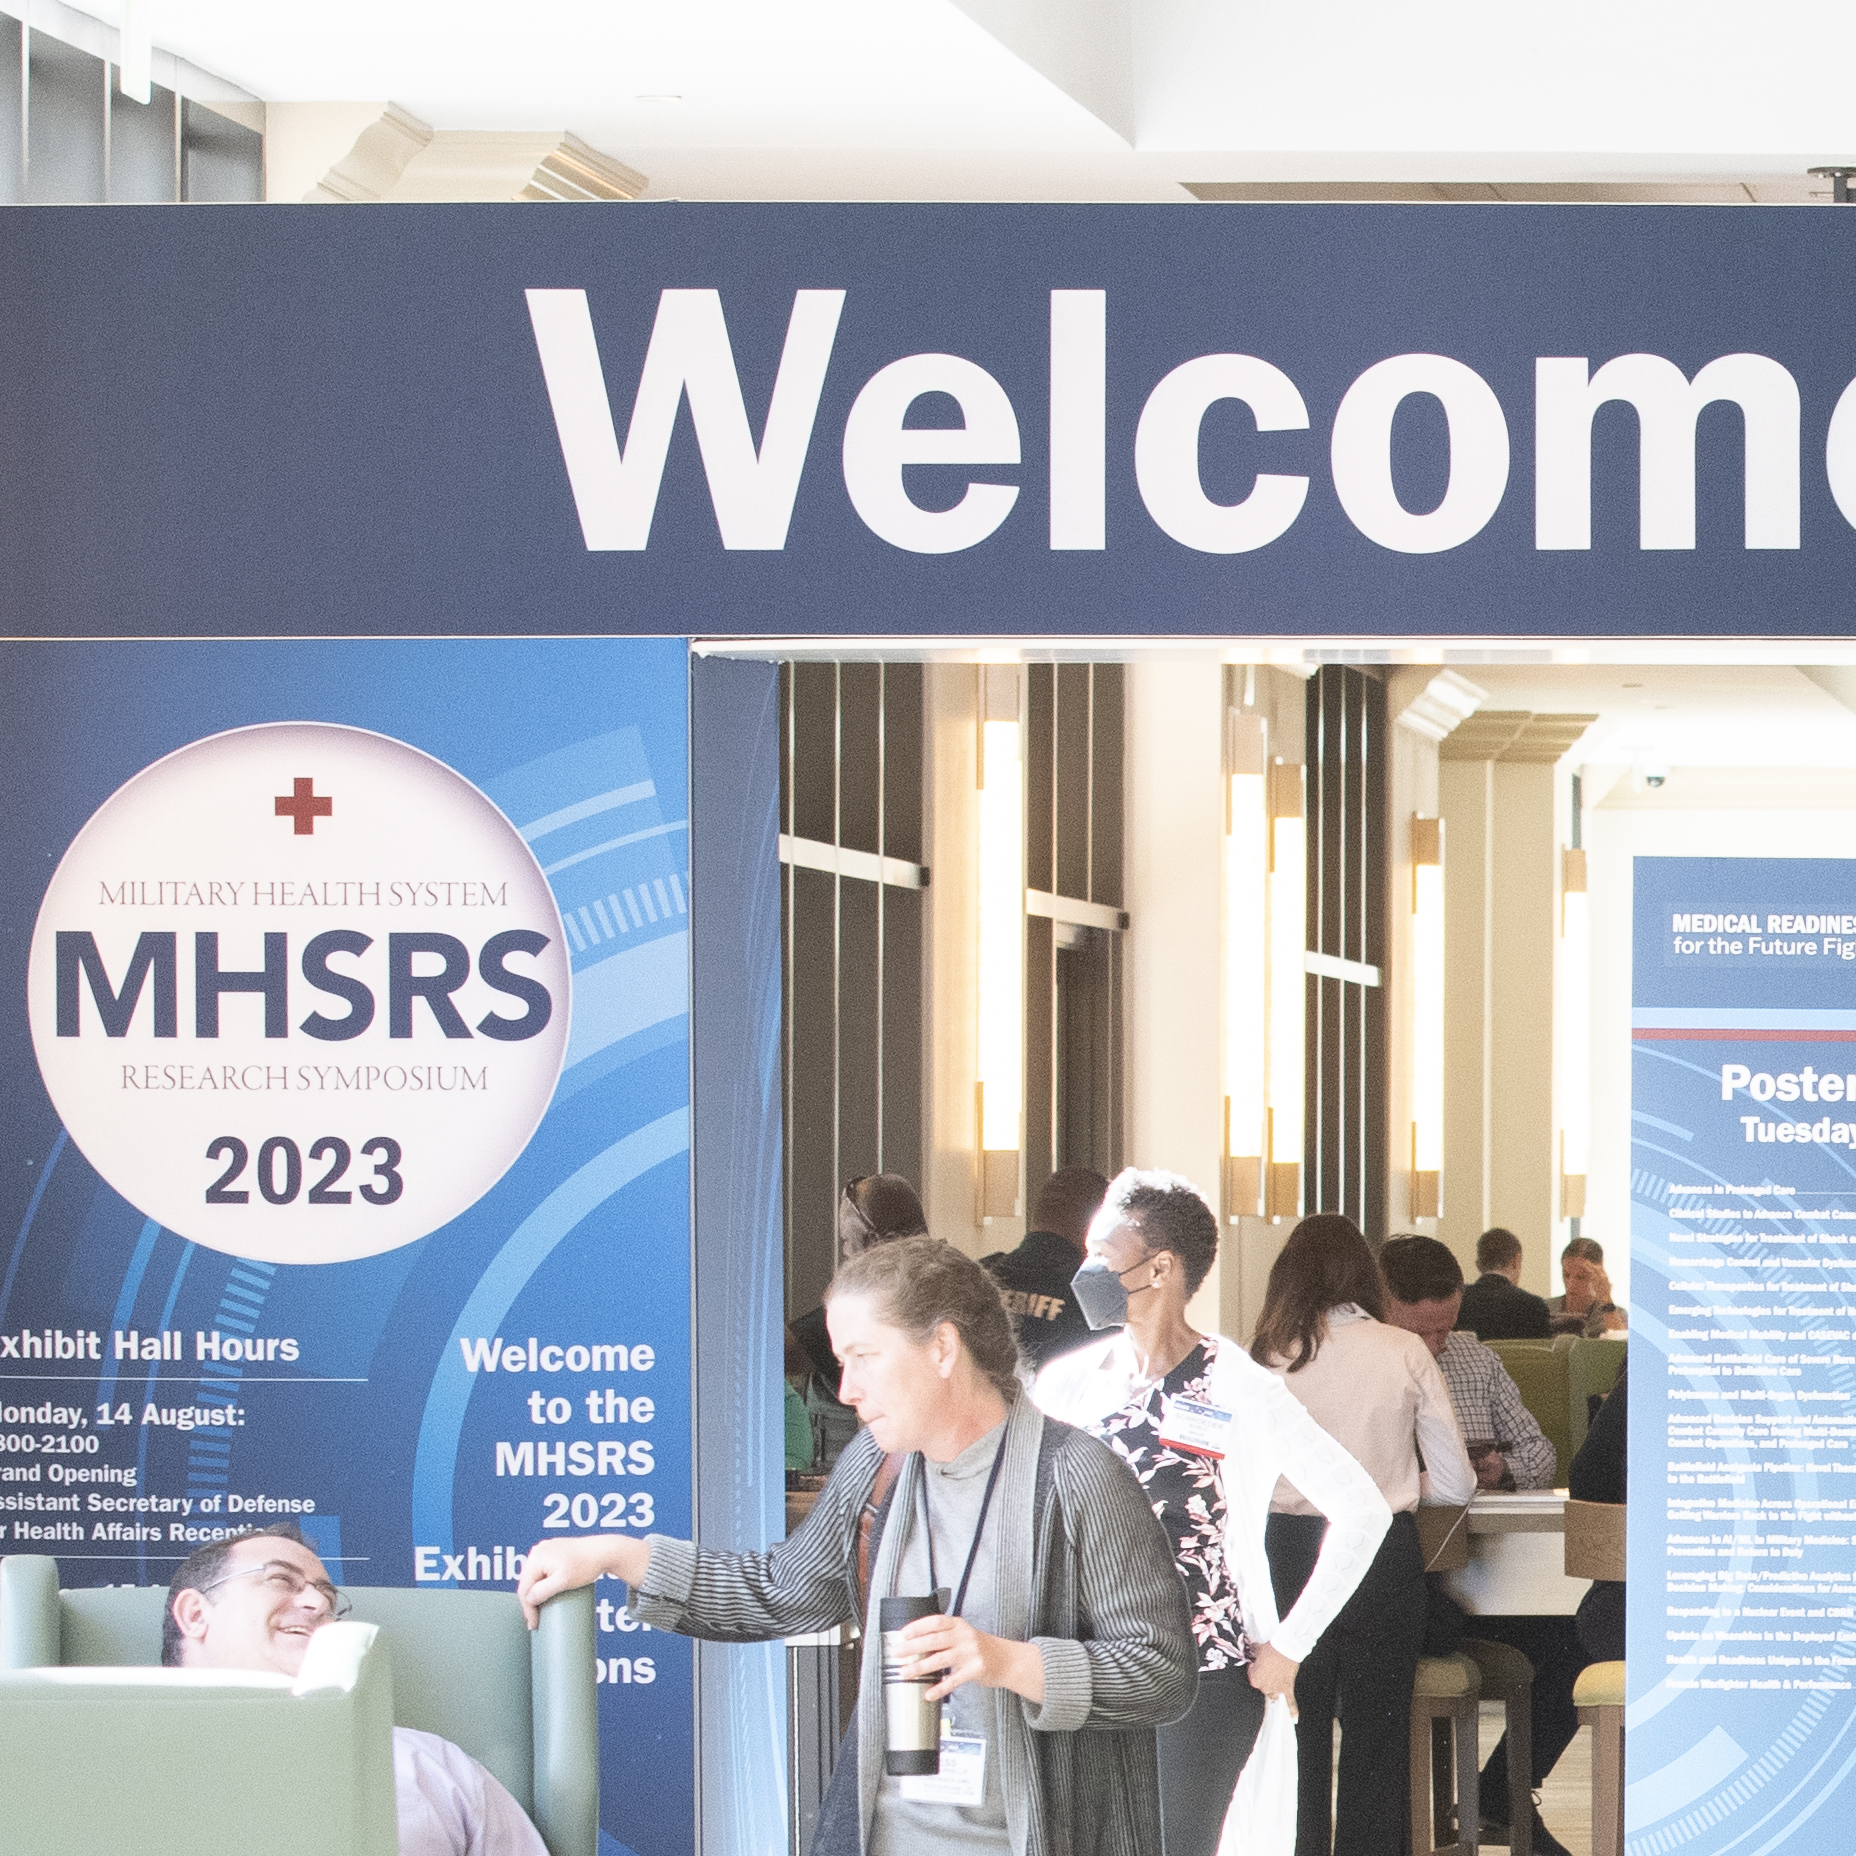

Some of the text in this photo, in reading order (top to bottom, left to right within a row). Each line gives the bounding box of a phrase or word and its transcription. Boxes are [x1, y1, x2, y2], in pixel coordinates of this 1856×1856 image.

[99, 880, 508, 907] MILITARY HEALTH SYSTEM
[1672, 913, 1762, 933] MEDICAL
[1673, 936, 1705, 954] for
[1707, 936, 1743, 955] the
[1748, 936, 1818, 956] Future
[55, 929, 553, 1042] MHSRS
[121, 1064, 487, 1092] RESEARCH SYMPOSIUM
[205, 1135, 403, 1206] 2023
[0, 1329, 300, 1361] xhibit Hall Hours
[459, 1337, 655, 1373] Welcome
[0, 1402, 245, 1431] onday, 14 August:
[527, 1389, 655, 1424] to the
[496, 1440, 655, 1476] MHSRS
[1, 1463, 137, 1487] and Opening
[87, 1493, 193, 1516] Secretary
[199, 1494, 221, 1513] of
[228, 1494, 315, 1513] Defense
[543, 1492, 655, 1528] 2023
[14, 1521, 84, 1540] Health
[91, 1522, 162, 1541] Affairs
[414, 1545, 524, 1582] Exhib
